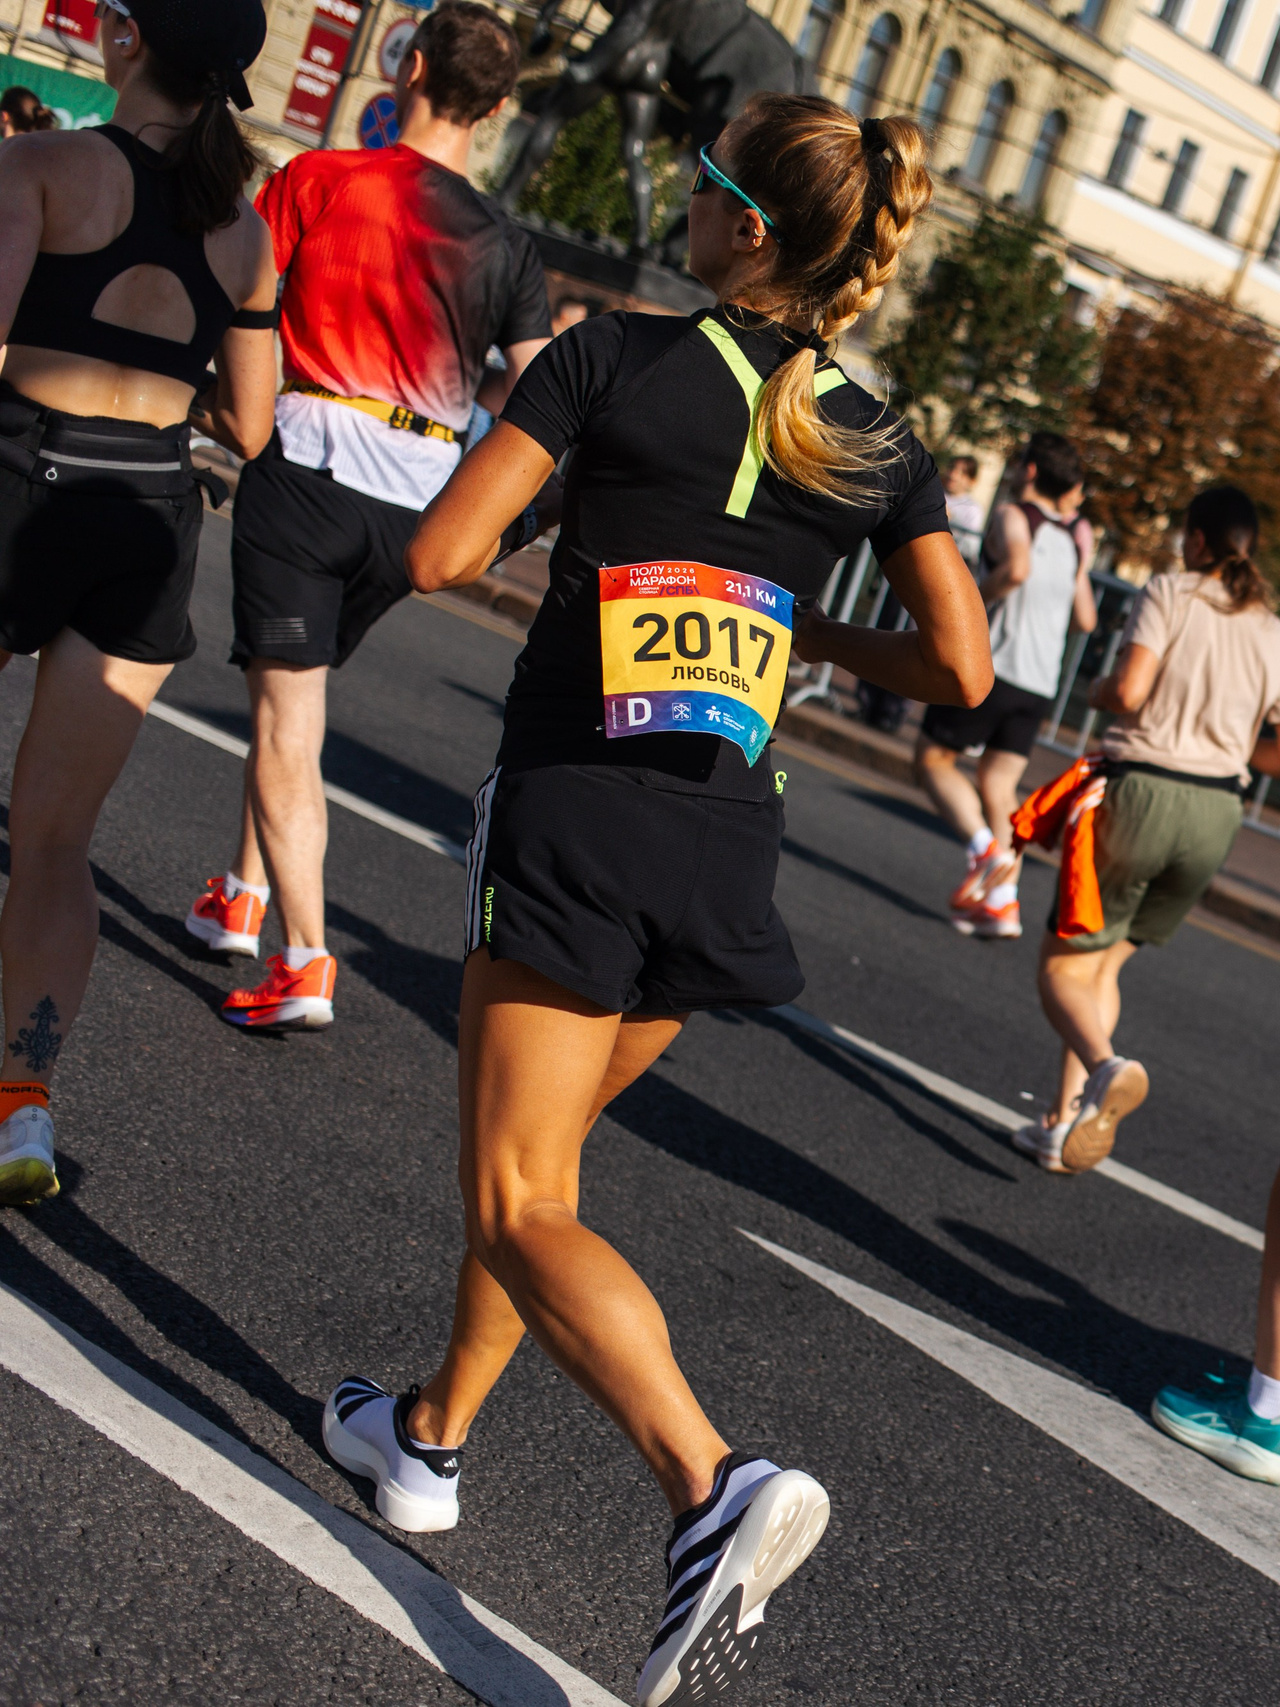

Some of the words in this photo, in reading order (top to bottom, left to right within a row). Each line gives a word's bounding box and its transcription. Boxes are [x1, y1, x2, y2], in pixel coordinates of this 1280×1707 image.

[629, 565, 665, 577] ПОЛУ
[629, 575, 696, 587] МАРАФОН
[725, 580, 751, 598] 21,1
[632, 611, 775, 680] 2017
[671, 666, 750, 694] ЛЮБОВЬ
[627, 697, 652, 727] D
